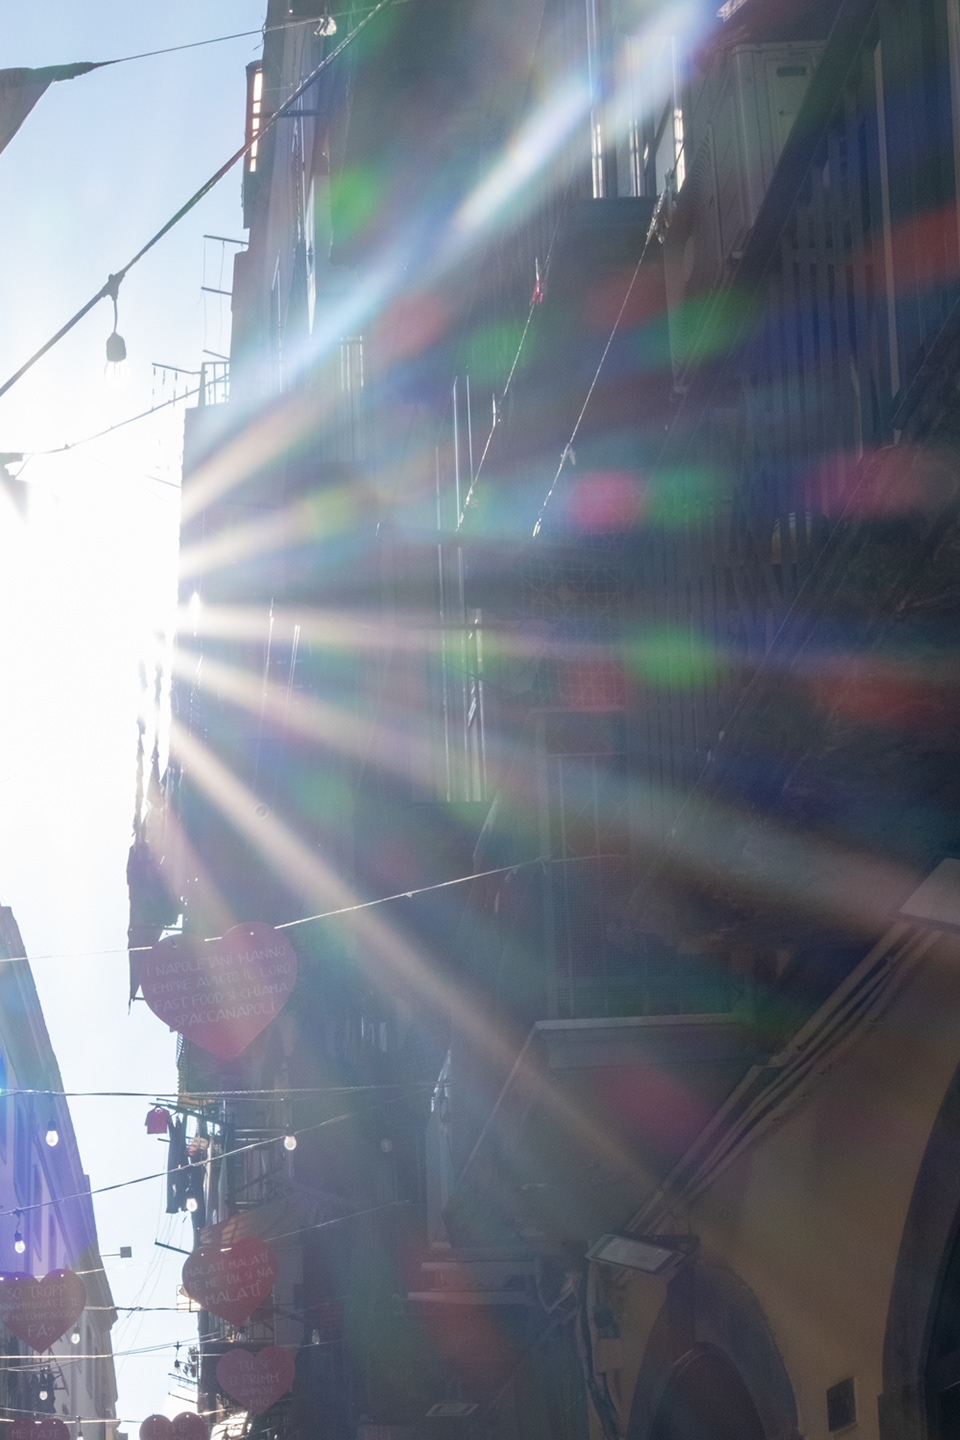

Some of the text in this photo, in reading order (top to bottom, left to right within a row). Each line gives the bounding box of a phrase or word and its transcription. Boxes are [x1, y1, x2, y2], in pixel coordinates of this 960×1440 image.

[155, 951, 233, 977] NAPOLETANI
[239, 944, 287, 962] HANNO
[148, 963, 291, 994] SEMPRE AVUTO IL LORO
[154, 997, 189, 1014] FAST
[191, 991, 224, 1007] FOOD
[240, 982, 289, 999] CHIAMA
[174, 998, 275, 1027] SPACCANAPOLI
[256, 1266, 274, 1278] NA
